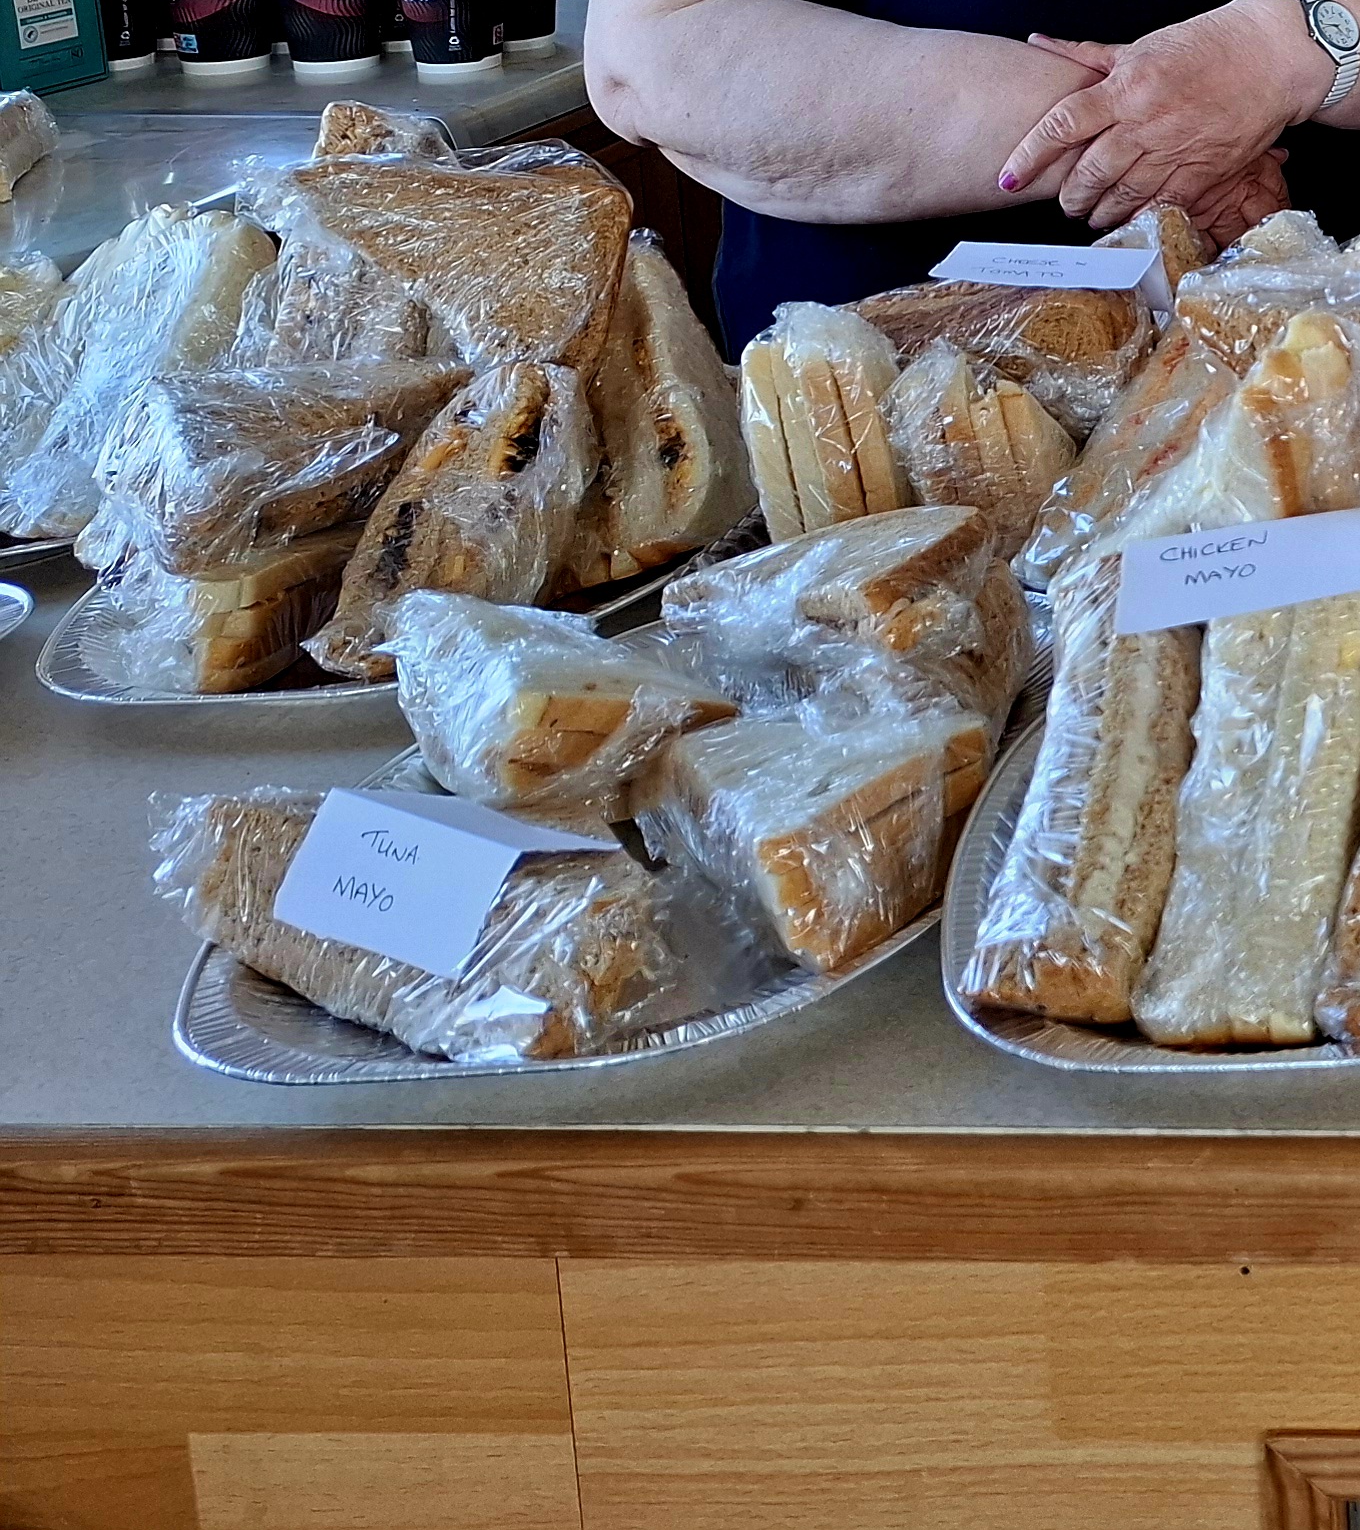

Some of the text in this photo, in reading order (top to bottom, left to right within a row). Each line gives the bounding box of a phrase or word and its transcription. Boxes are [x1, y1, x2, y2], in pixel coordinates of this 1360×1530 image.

[17, 0, 55, 13] ORIGINAL
[992, 256, 1060, 267] CHEESE
[971, 266, 1064, 278] TOMATO
[1159, 530, 1268, 561] CHICKEN
[1184, 563, 1257, 586] MAYO
[333, 875, 394, 912] MAYO
